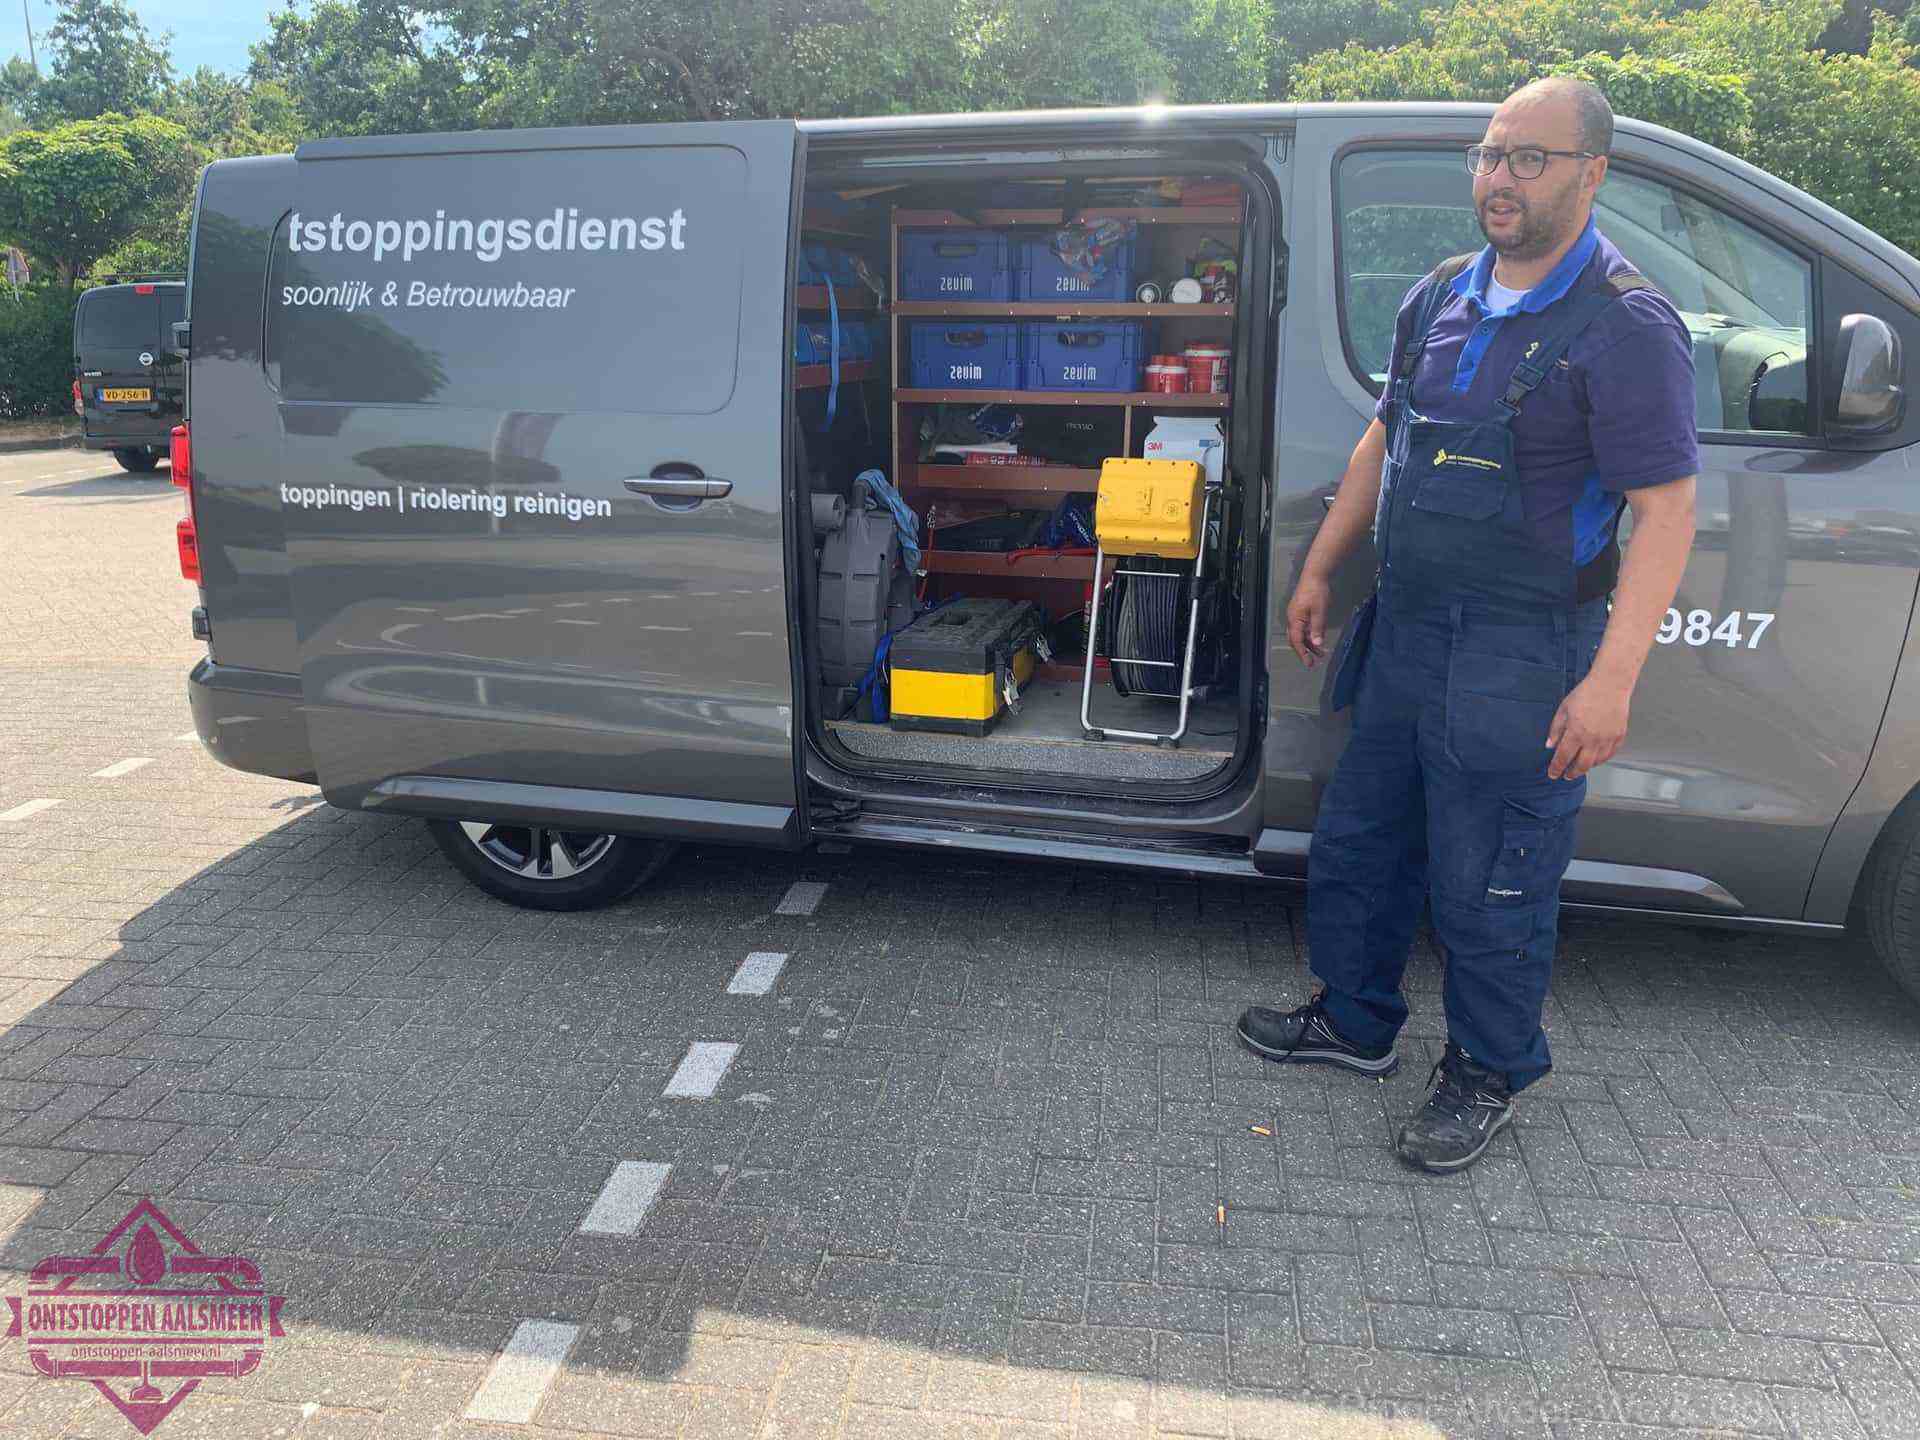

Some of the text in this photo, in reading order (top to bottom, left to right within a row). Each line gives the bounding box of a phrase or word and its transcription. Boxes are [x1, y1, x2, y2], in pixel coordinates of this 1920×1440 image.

[289, 208, 687, 261] tstoppingsdienst
[283, 281, 575, 312] soonlijk & Betrouwbaar
[1147, 441, 1163, 451] 3M
[280, 483, 391, 511] toppingen
[411, 487, 507, 517] riolering
[514, 493, 612, 521] reinigen
[1655, 607, 1776, 649] 9847
